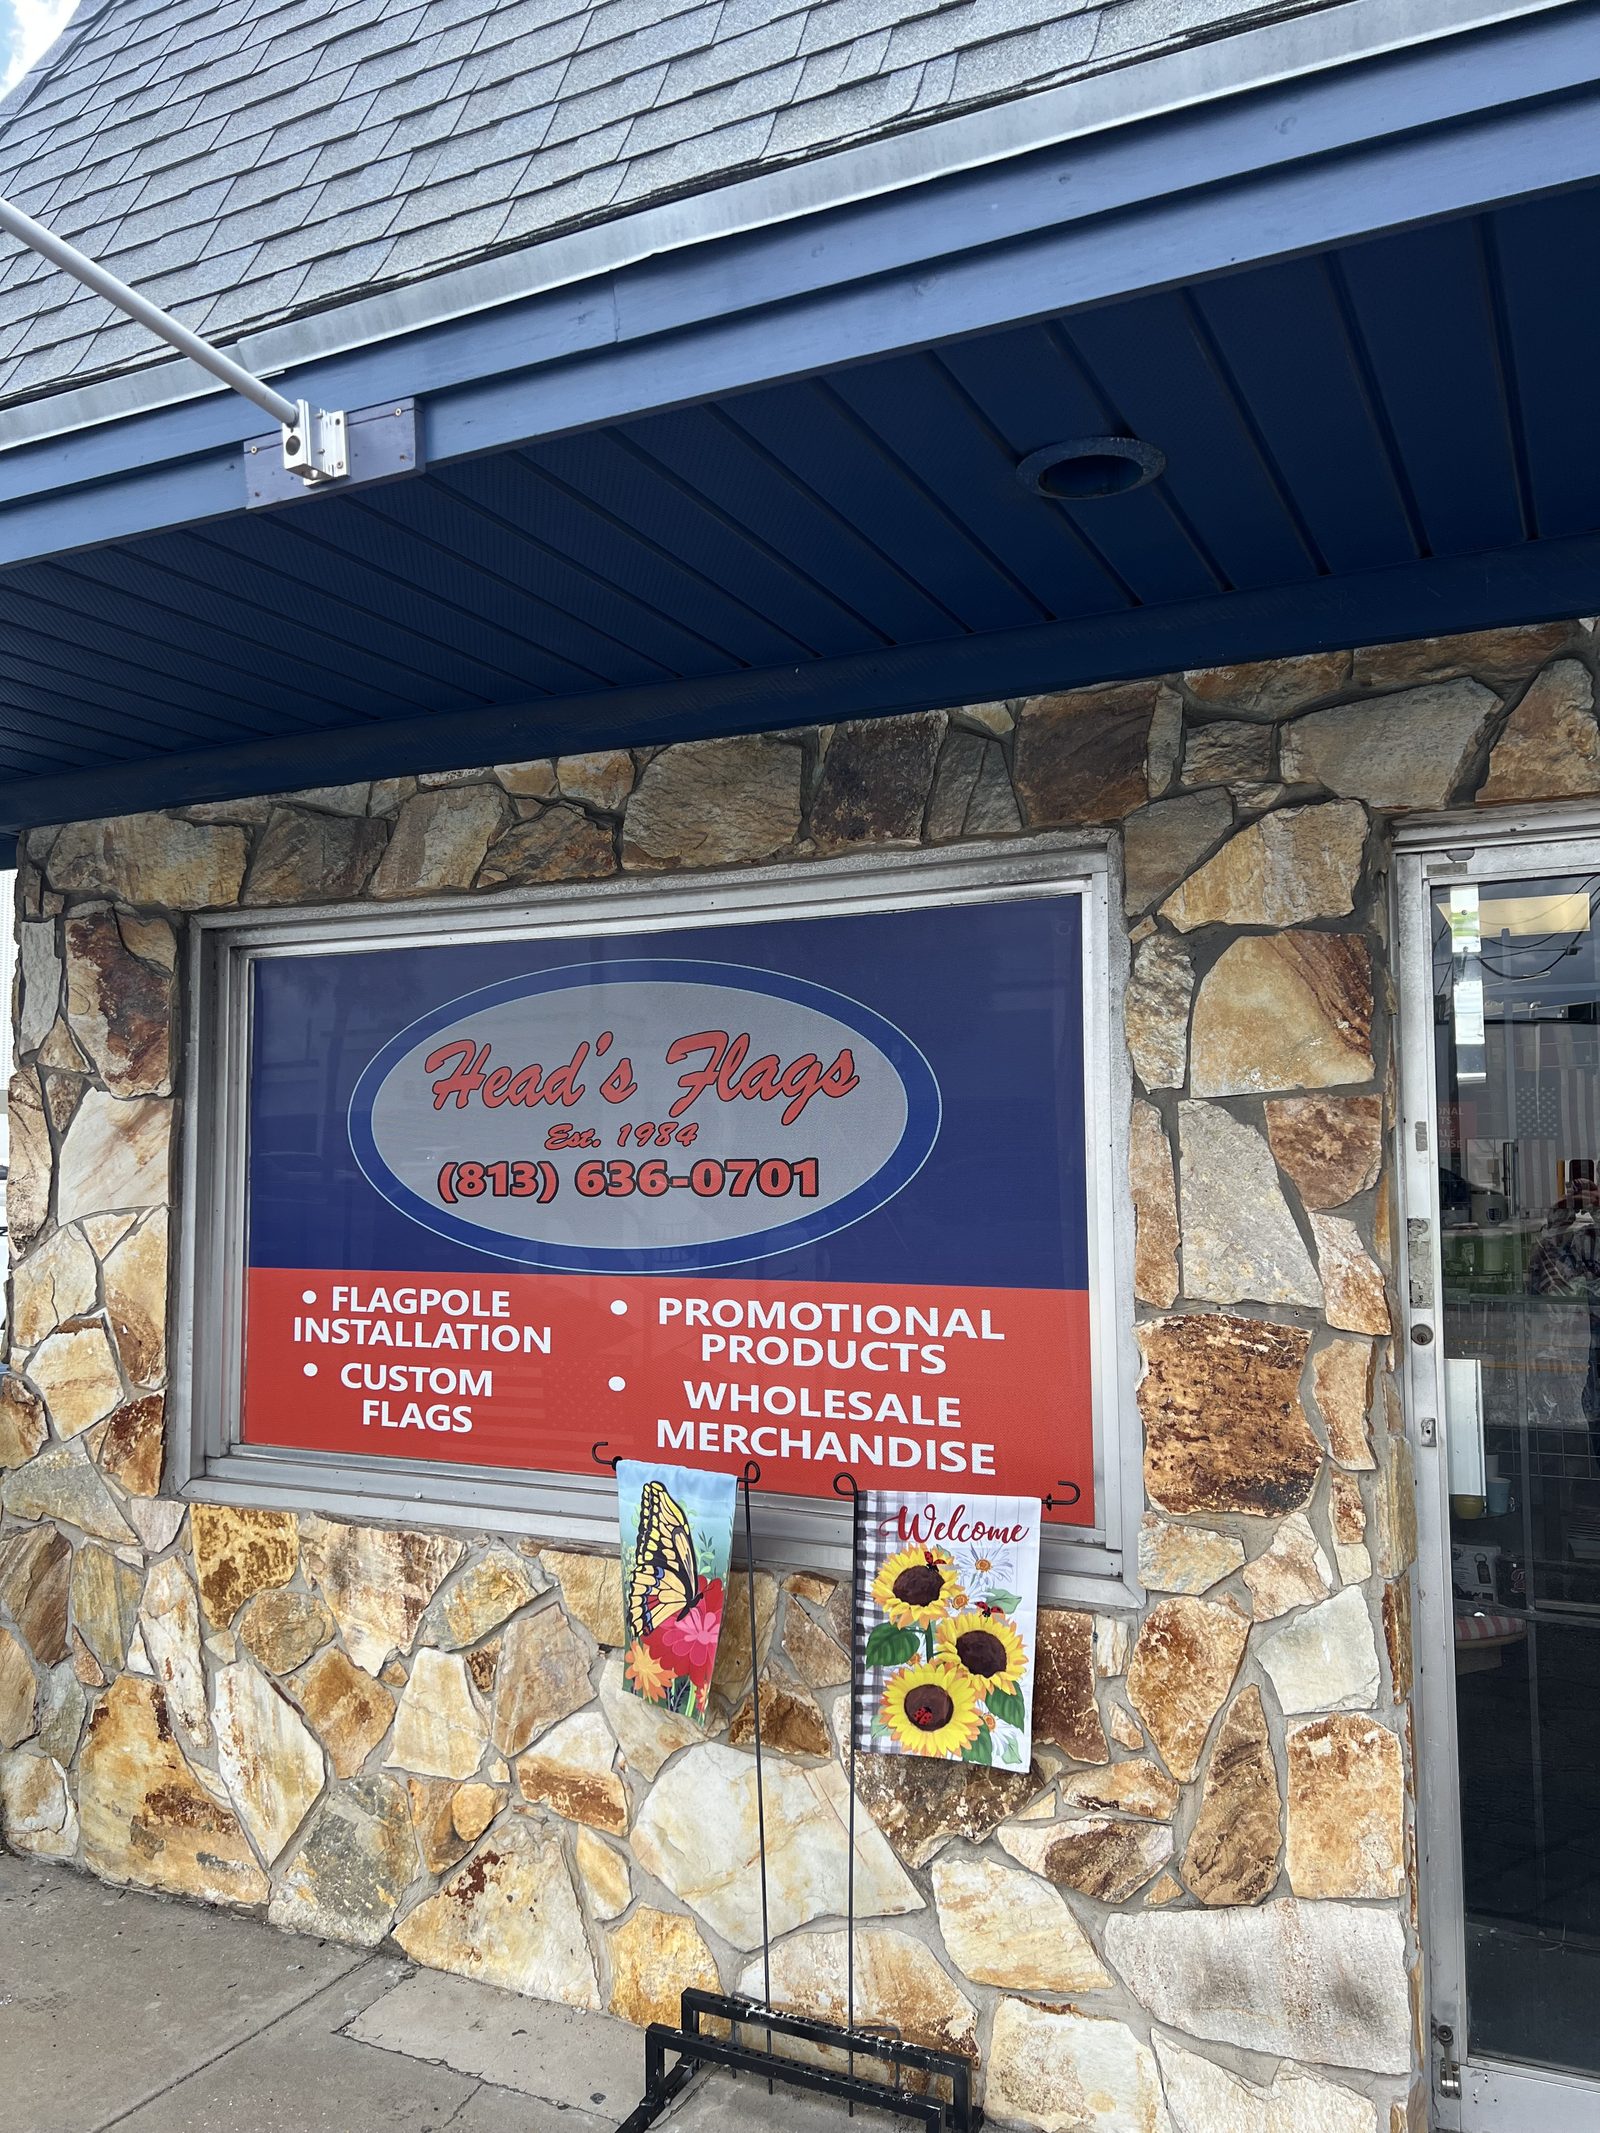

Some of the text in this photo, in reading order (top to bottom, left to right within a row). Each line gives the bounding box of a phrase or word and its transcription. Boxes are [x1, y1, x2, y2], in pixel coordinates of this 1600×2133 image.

[425, 1030, 860, 1126] Head's Flags
[544, 1122, 699, 1150] Est. 1984
[437, 1158, 820, 1204] (813) 636-0701
[332, 1286, 511, 1317] FLAGPOLE
[658, 1297, 1006, 1341] PROMOTIONAL
[294, 1316, 551, 1353] INSTALLATION
[701, 1333, 947, 1375] PRODUCTS
[340, 1362, 492, 1397] CUSTOM
[362, 1400, 473, 1433] FLAGS
[683, 1380, 962, 1428] WHOLESALE
[656, 1420, 997, 1475] MERCHANDISE
[879, 1503, 1029, 1543] Welcome
